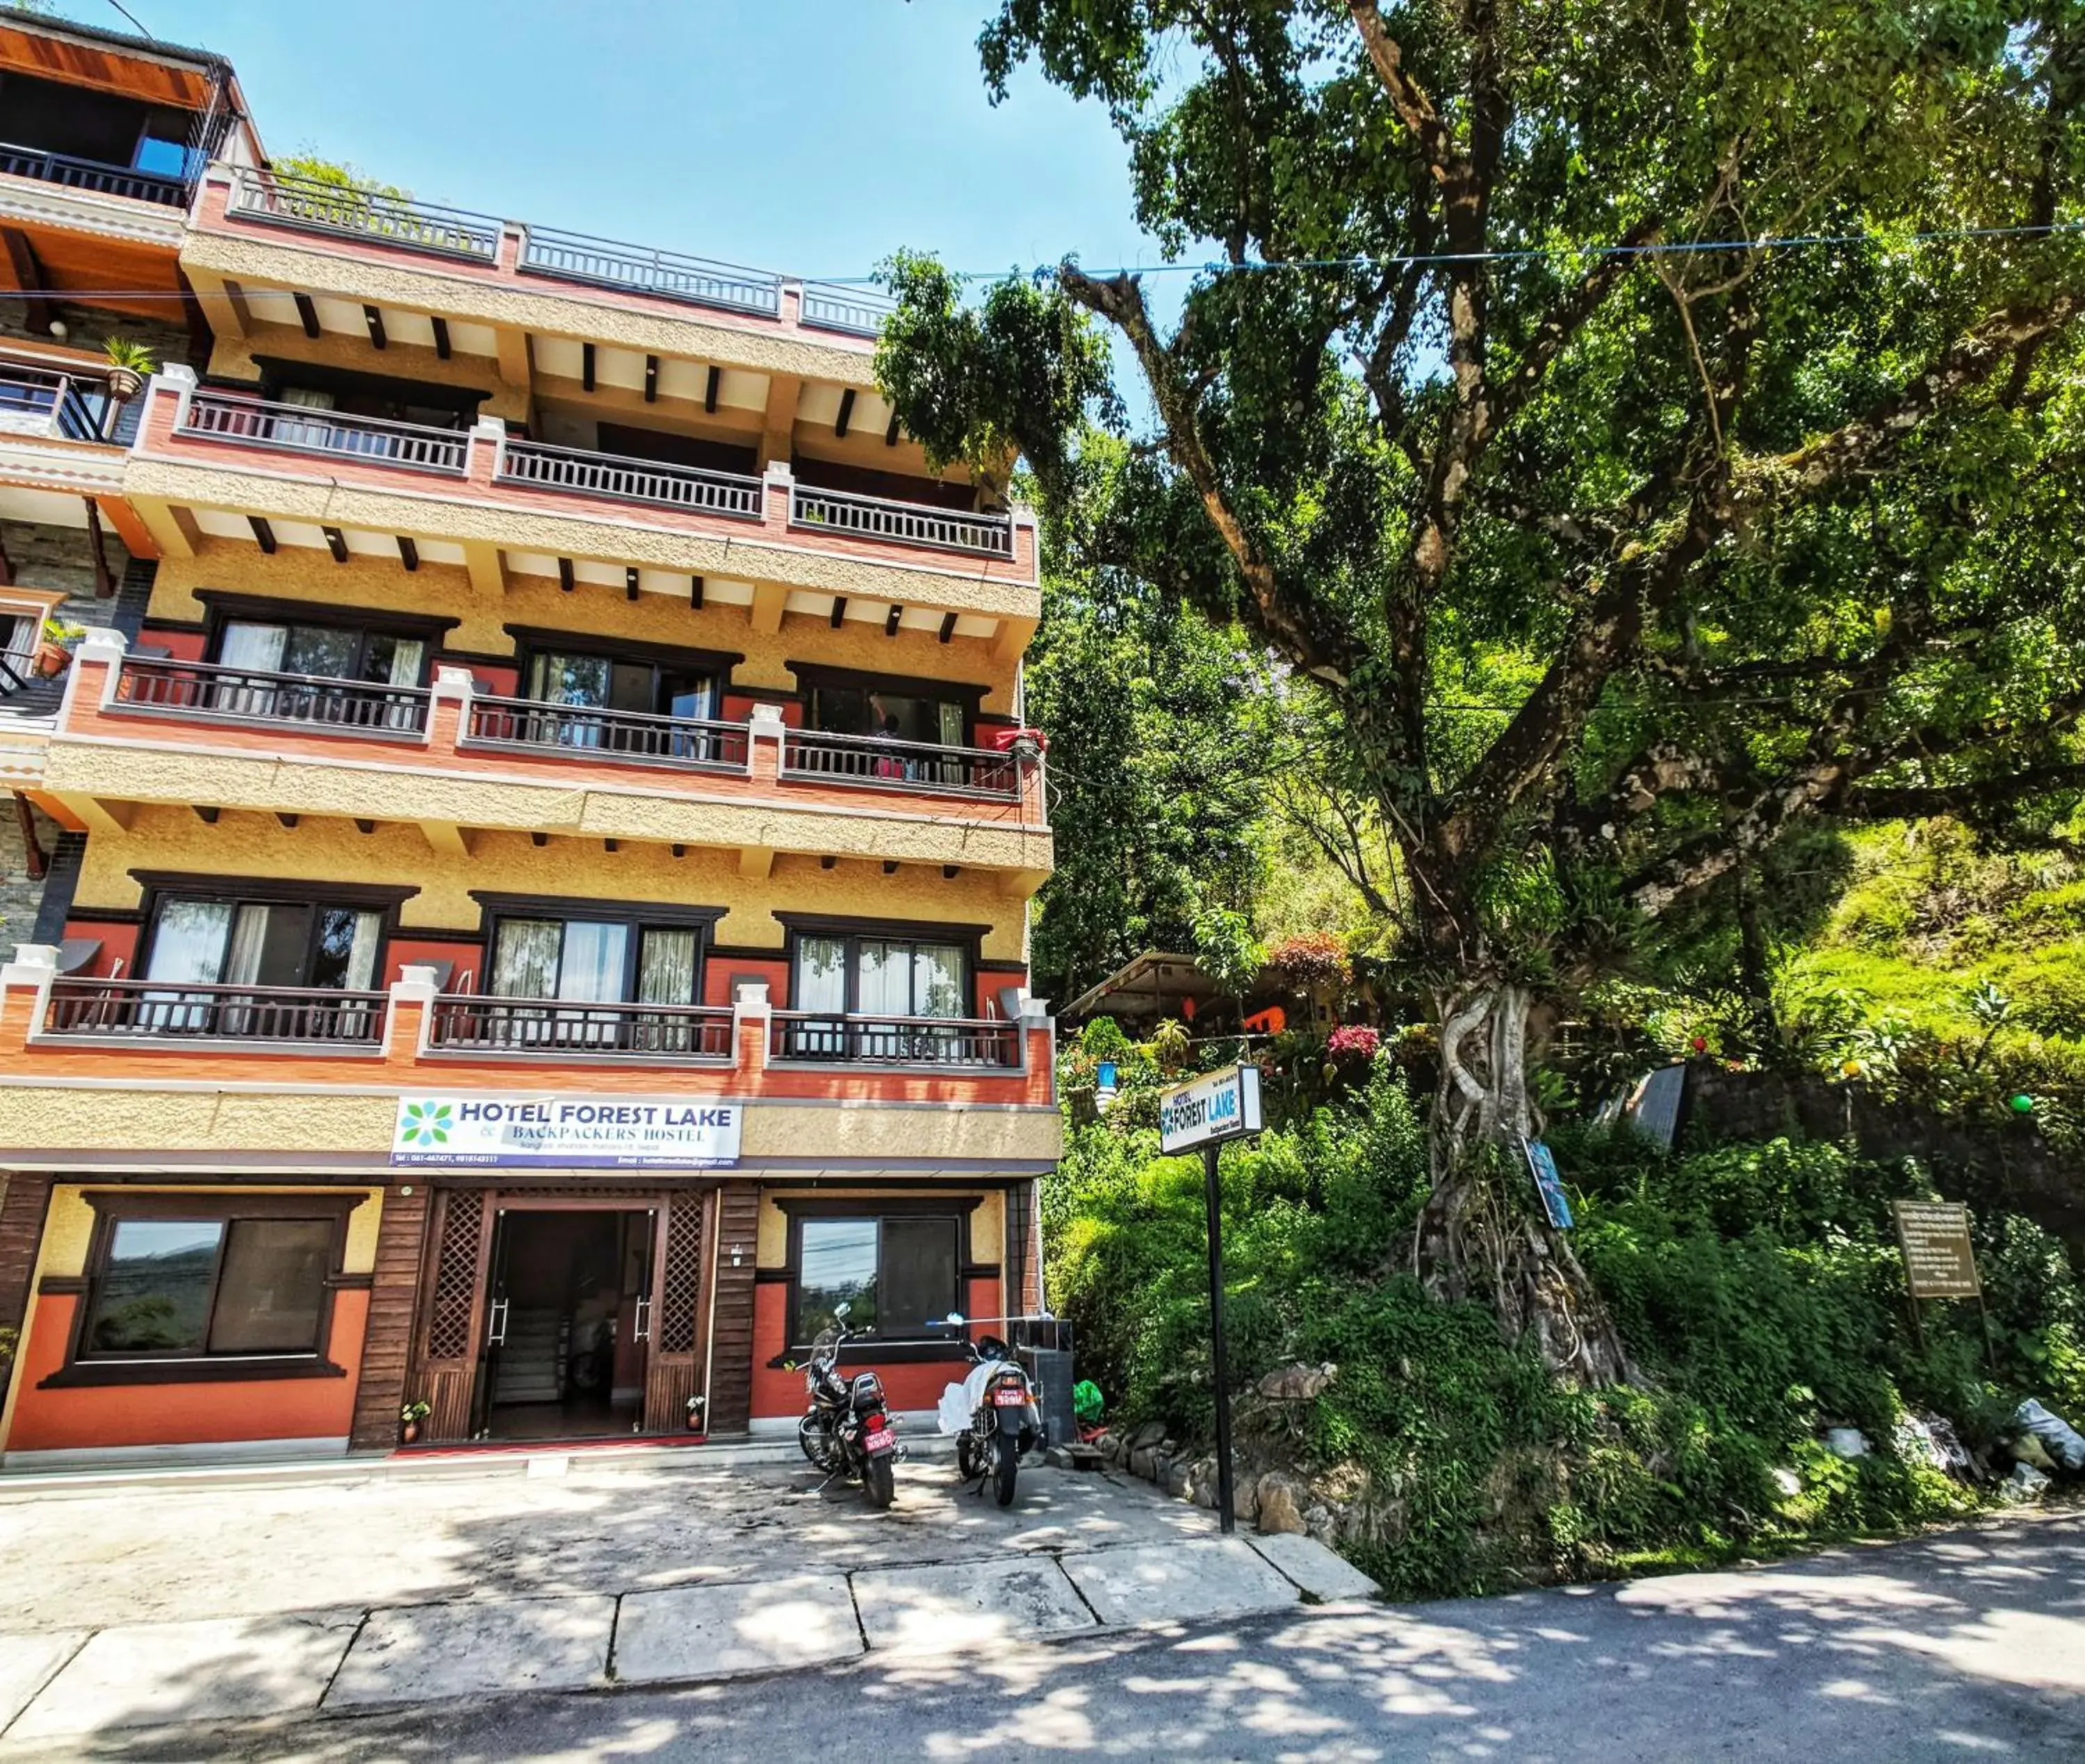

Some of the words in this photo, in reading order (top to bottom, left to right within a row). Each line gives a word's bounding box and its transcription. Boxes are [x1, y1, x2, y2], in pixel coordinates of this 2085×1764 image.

[459, 1103, 551, 1122] HOTEL
[559, 1105, 658, 1125] FOREST
[664, 1108, 732, 1127] LAKE
[1174, 1098, 1206, 1133] FOREST
[1209, 1089, 1235, 1120] LAKE
[644, 1128, 705, 1142] HOSTEL
